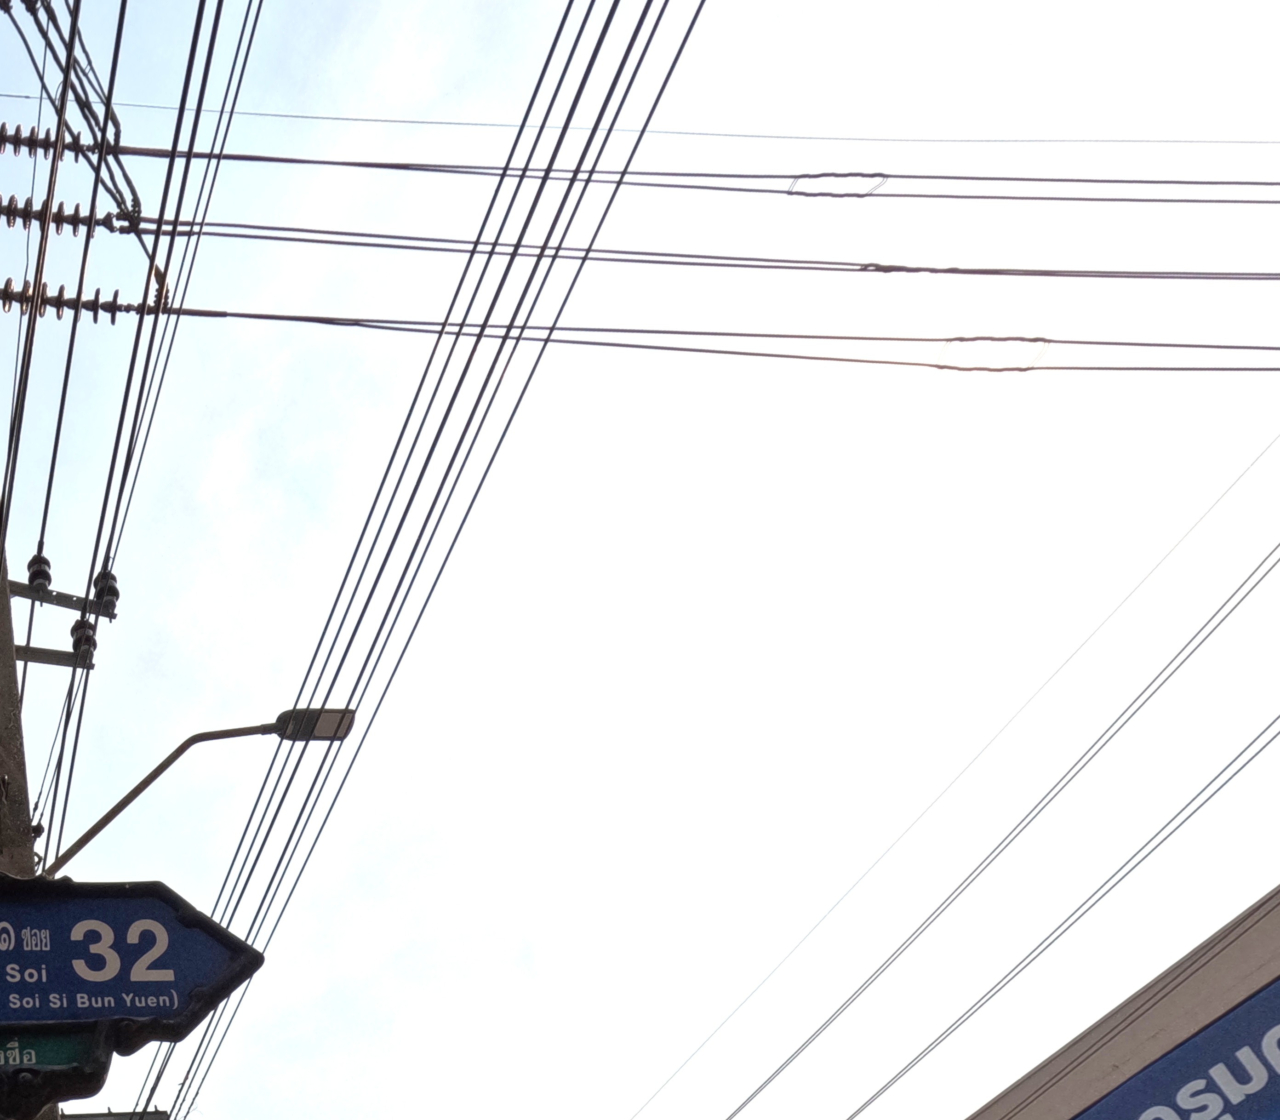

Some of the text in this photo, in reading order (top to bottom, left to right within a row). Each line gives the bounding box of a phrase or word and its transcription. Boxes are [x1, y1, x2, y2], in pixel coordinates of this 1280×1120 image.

[22, 926, 50, 951] ซอย
[71, 919, 175, 982] 32
[6, 963, 48, 983] Soi
[8, 989, 179, 1010] Soi Si Bun Yuen)
